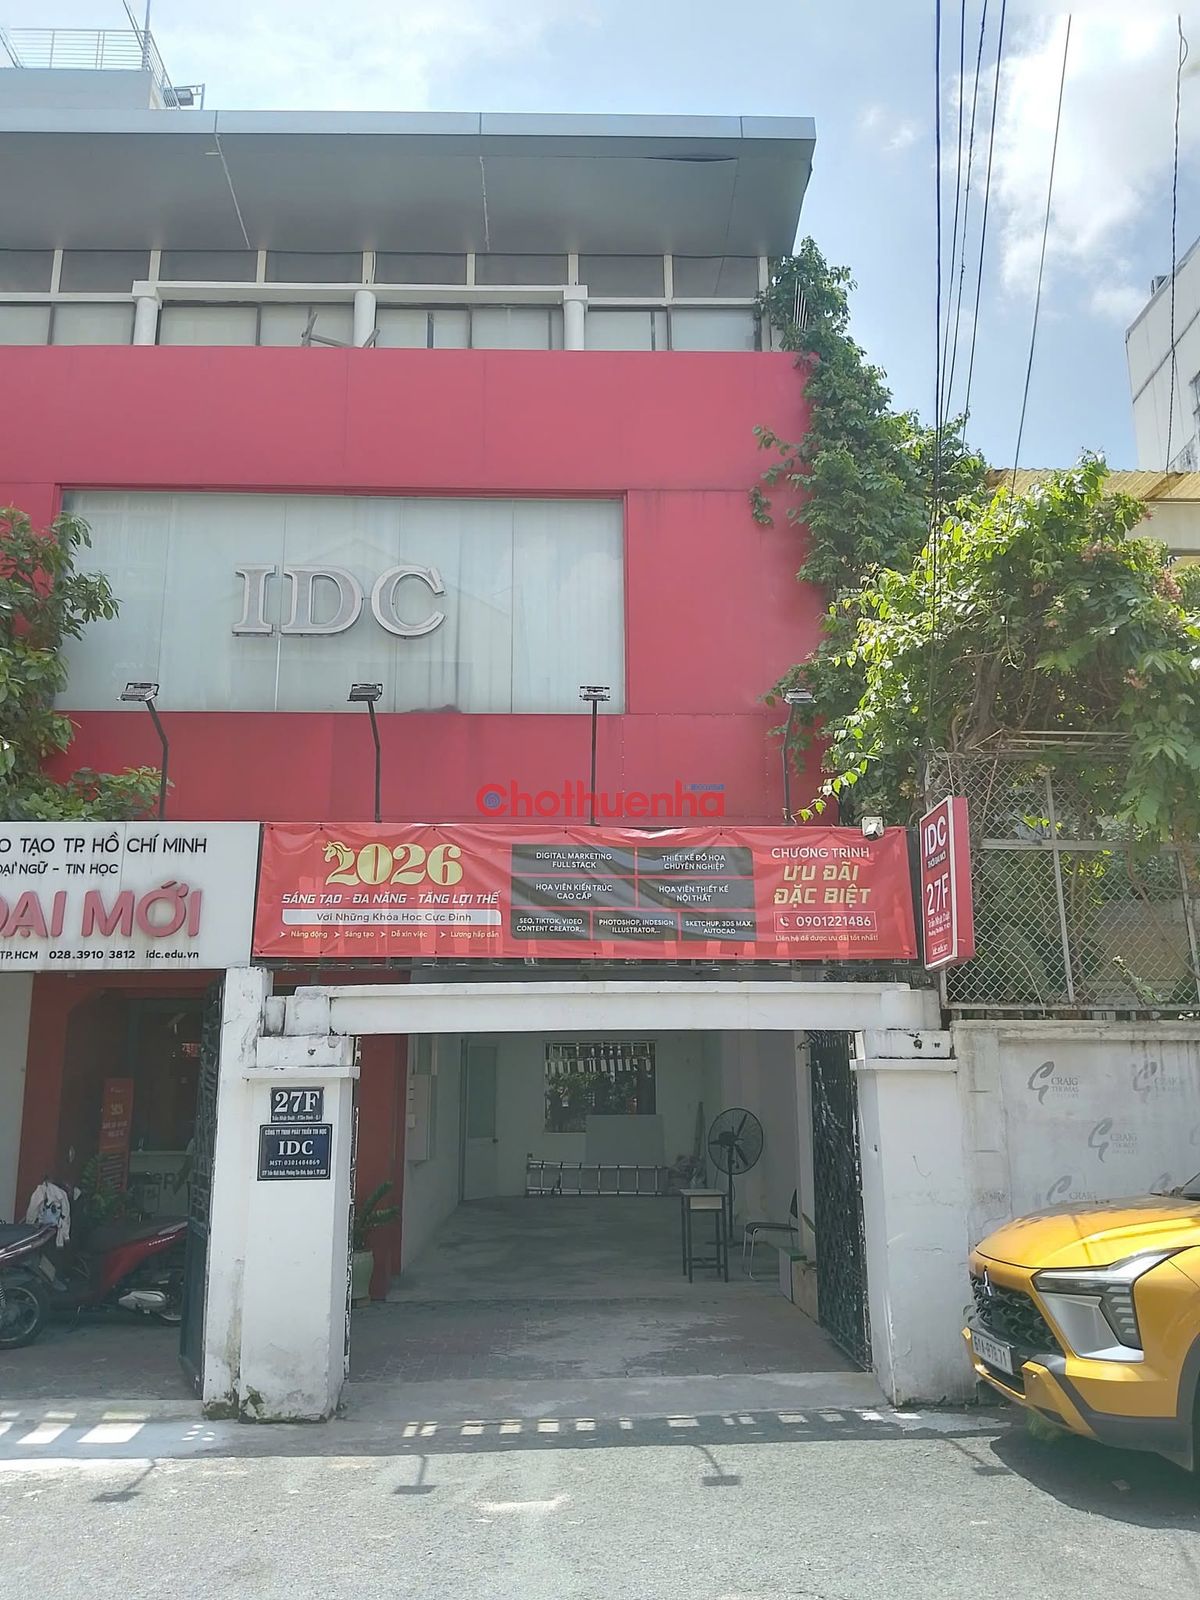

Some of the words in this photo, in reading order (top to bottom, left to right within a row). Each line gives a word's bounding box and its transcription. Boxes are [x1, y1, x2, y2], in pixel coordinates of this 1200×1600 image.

[232, 564, 446, 637] IDC
[924, 815, 947, 858] IDC
[20, 838, 55, 856] TẠO
[64, 838, 85, 853] TP.
[92, 832, 119, 853] HỒ
[127, 833, 157, 853] CHÍ
[163, 838, 207, 853] MINH
[536, 852, 566, 860] DIGITAL
[662, 853, 682, 862] THIẾT
[685, 853, 694, 861] KẾ
[708, 854, 726, 863] HỌA
[771, 847, 828, 858] CHƯƠNG
[831, 845, 870, 858] TRÌNH
[19, 861, 48, 875] NGỮ
[66, 864, 85, 875] TIN
[90, 864, 118, 877] HỌC
[321, 840, 463, 886] 2026
[664, 862, 695, 870] CHUYÊN
[696, 861, 725, 871] NGHIỆP
[783, 864, 816, 881] ƯU
[823, 861, 859, 881] ĐÃI
[536, 883, 553, 892] HỌA
[554, 883, 572, 891] VIÊN
[574, 883, 591, 891] KIẾN
[593, 883, 613, 892] TRÚC
[696, 884, 717, 893] THIẾT
[719, 884, 729, 893] KẾ
[281, 891, 316, 904] SÁNG
[320, 894, 342, 906] TẠO
[352, 894, 369, 904] ĐA
[373, 891, 406, 904] NĂNG
[418, 891, 450, 904] TĂNG
[452, 894, 473, 906] LỢI
[476, 890, 501, 904] THẾ
[576, 891, 592, 900] CẤP
[676, 894, 690, 903] NỘI
[692, 893, 711, 902] THẤT
[774, 884, 817, 908] ĐẶC
[824, 884, 871, 908] BIỆT
[926, 873, 949, 916] 27F
[81, 880, 203, 938] MỚI
[336, 912, 369, 922] Những
[373, 912, 398, 921] Khóa
[402, 913, 422, 922] Học
[425, 913, 445, 922] Cực
[796, 916, 871, 927] 0901221486
[686, 920, 720, 928] SKETCHUP,
[49, 950, 104, 960] 028.3910
[108, 950, 135, 960] 3812
[146, 950, 199, 960] idc.edu.vn
[1051, 1077, 1079, 1086] CRAIG
[274, 1091, 320, 1113] 27F
[278, 1140, 313, 1155] IDC
